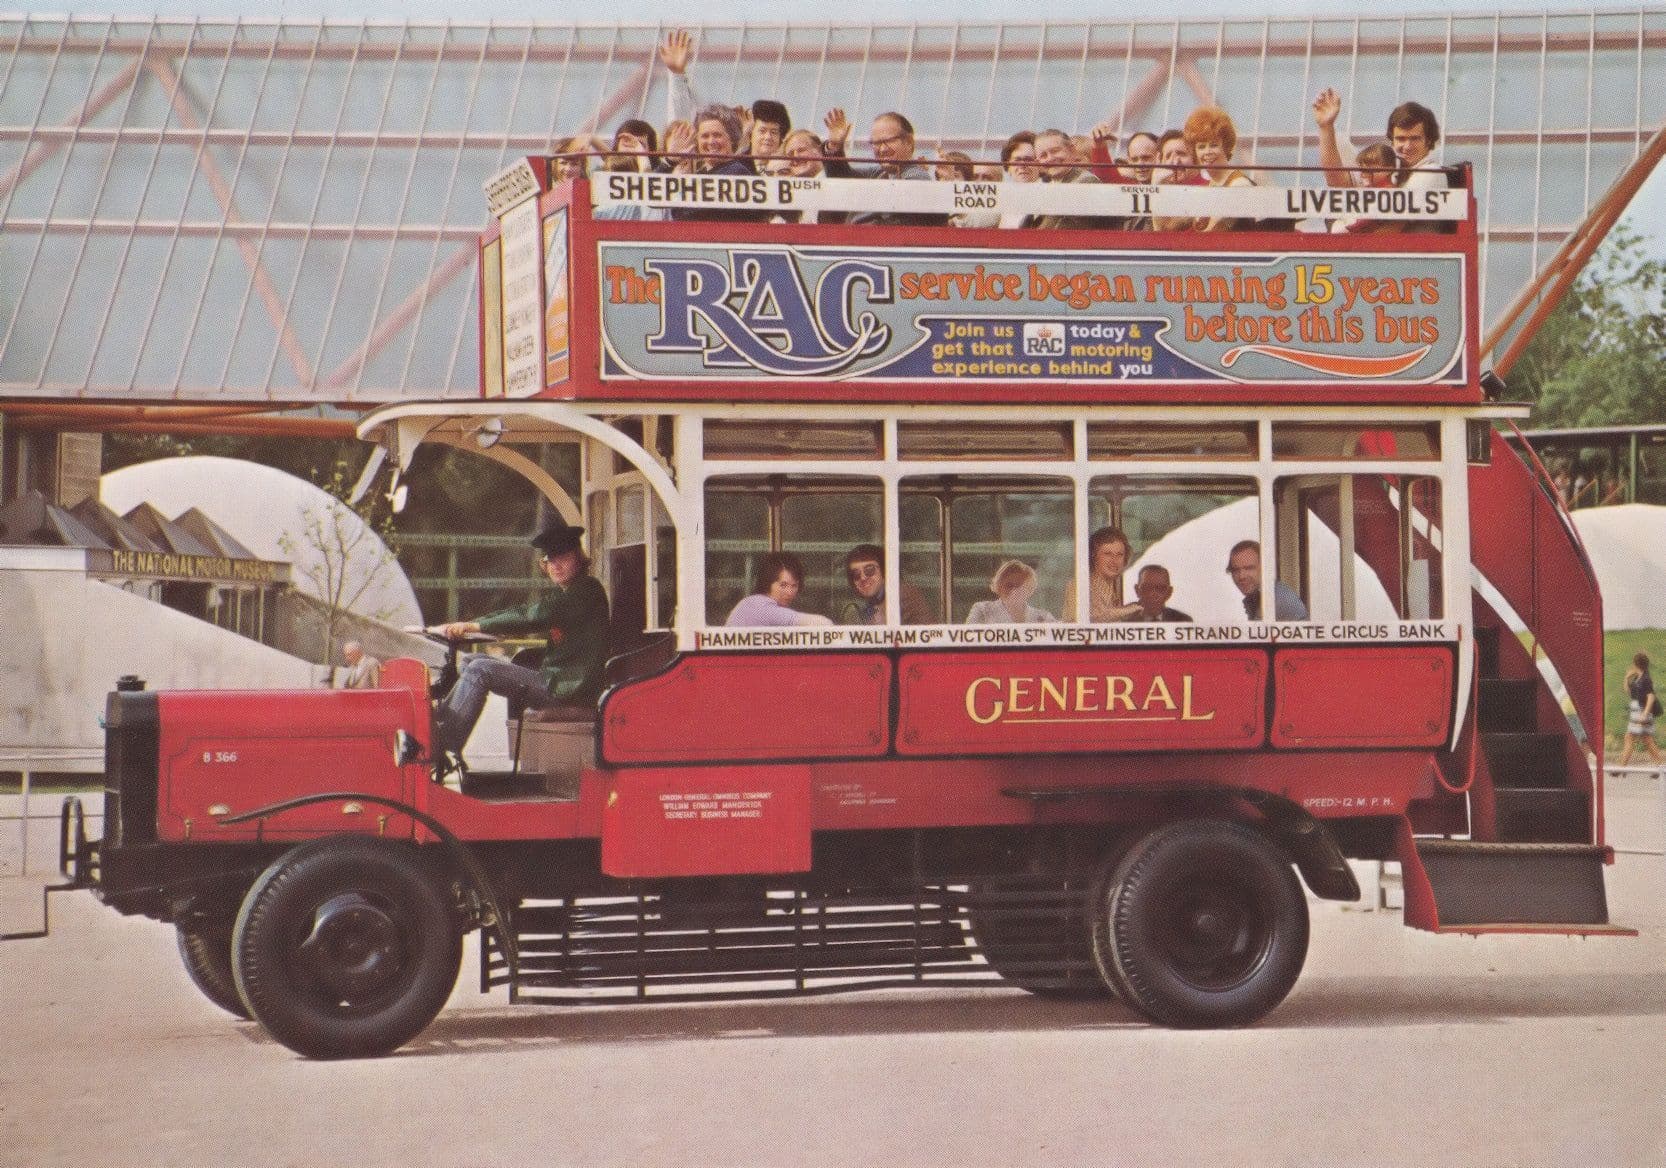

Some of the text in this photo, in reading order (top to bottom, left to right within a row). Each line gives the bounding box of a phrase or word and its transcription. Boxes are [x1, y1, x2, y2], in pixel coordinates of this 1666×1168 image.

[609, 175, 768, 204] SHEPHERDS
[953, 184, 997, 195] LAWN
[1120, 186, 1160, 194] SERVICE
[954, 197, 997, 208] ROAD
[1131, 194, 1153, 214] 11
[1287, 189, 1421, 214] LIVERPOOL
[606, 250, 1440, 376] The RAC service began running 15 years
[944, 322, 1142, 342] Join us today &
[1184, 303, 1440, 344] before this bus
[932, 341, 1153, 361] get that motoring
[1026, 338, 1064, 354] RAC
[932, 360, 1153, 380] experience behind you
[113, 550, 134, 571] THE
[137, 552, 194, 577] NATIONAL
[700, 631, 820, 647] HAMMERSMITH
[849, 630, 916, 645] WALHAM
[948, 628, 1021, 643] VICTORIA
[1052, 627, 1167, 642] WESTMINSTER
[1174, 626, 1242, 641] STRAND
[1249, 625, 1325, 640] LUDGATE
[1331, 624, 1389, 639] CIRCUS
[1400, 624, 1445, 638] BANK
[964, 675, 1216, 724] GENERAL
[215, 751, 238, 763] 366
[659, 793, 682, 801] LONDON
[663, 802, 690, 811] WILLIAM
